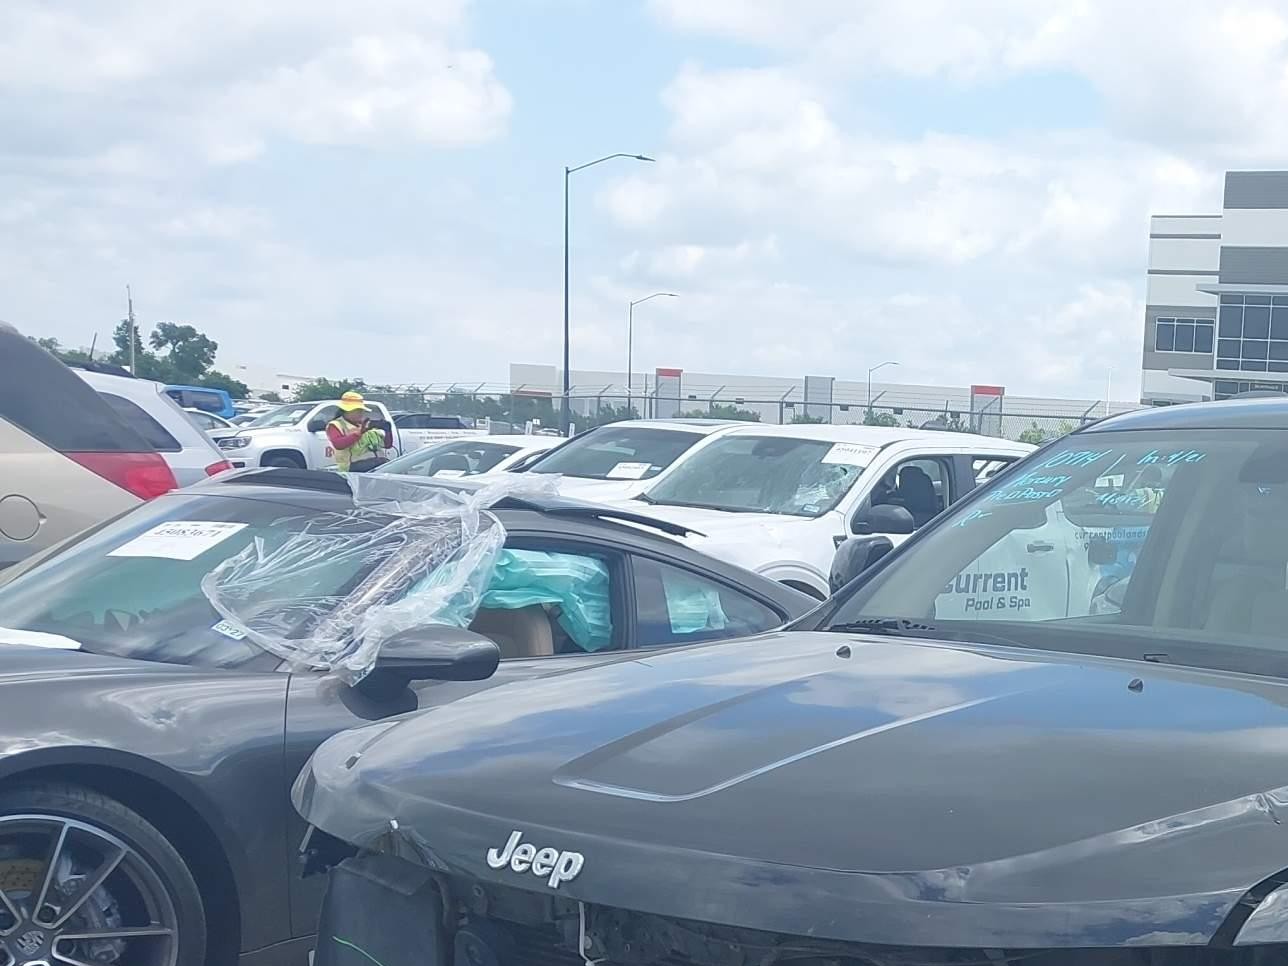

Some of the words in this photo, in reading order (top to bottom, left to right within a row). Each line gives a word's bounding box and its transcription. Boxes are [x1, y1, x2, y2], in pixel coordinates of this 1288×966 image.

[964, 596, 994, 612] Pool
[996, 596, 1006, 609] &
[1008, 595, 1031, 609] Spa
[486, 830, 585, 889] Jeep
